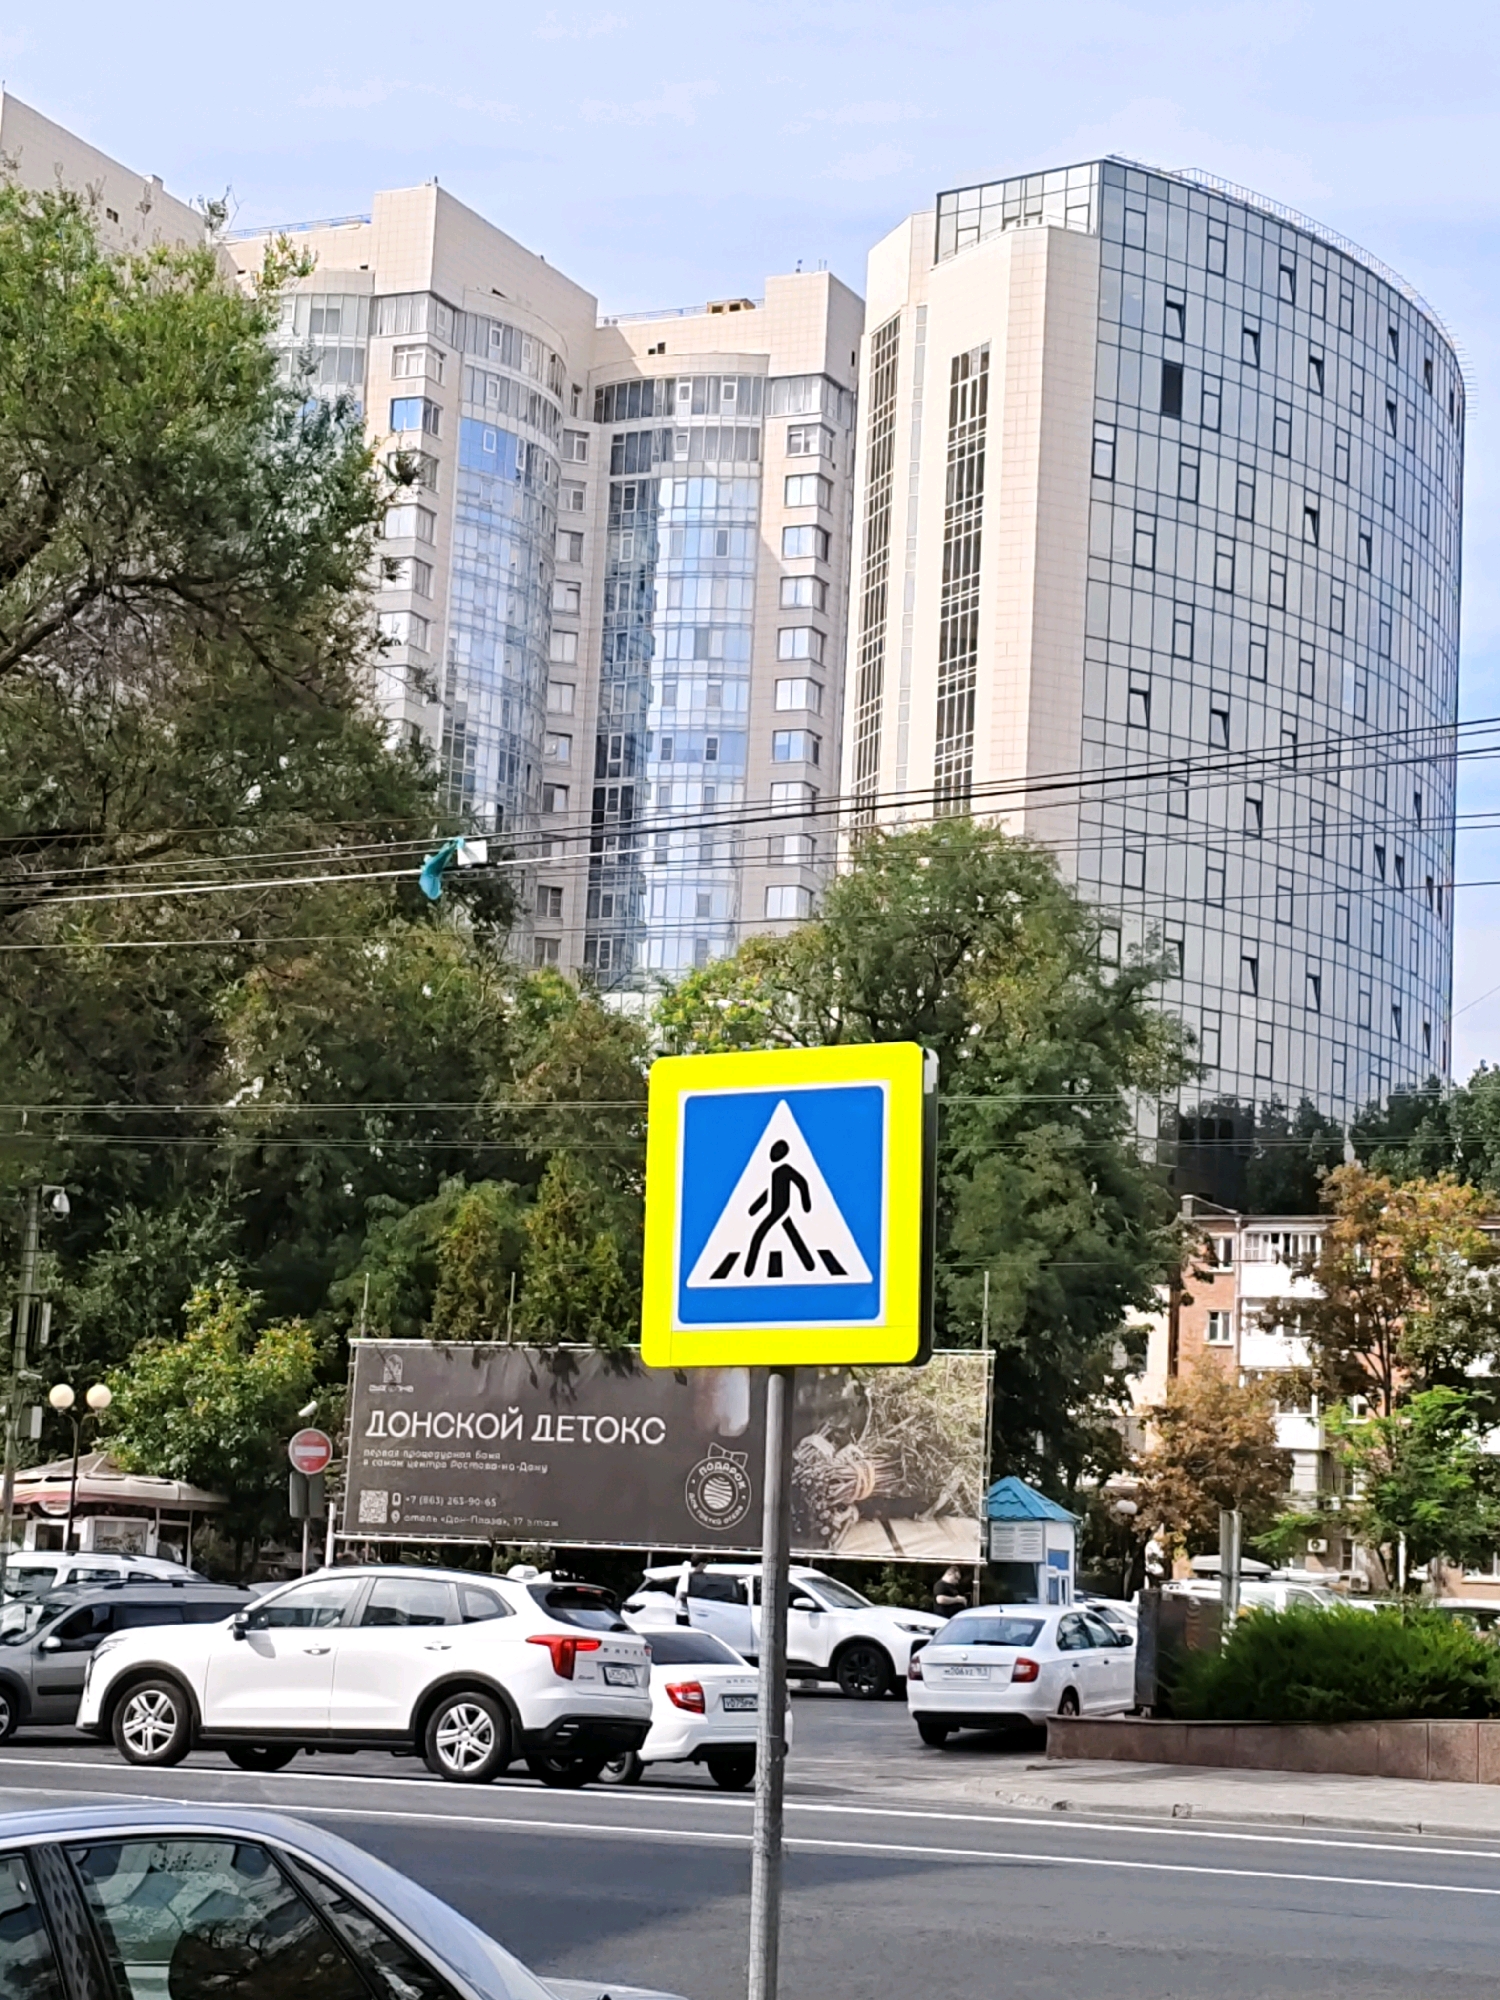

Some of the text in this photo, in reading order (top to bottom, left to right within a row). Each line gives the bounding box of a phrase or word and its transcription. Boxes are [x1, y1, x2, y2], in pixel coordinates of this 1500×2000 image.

[364, 1406, 667, 1445] ДОНСКОЙ ДЕТОКС
[363, 1449, 400, 1458] первая
[698, 1461, 747, 1490] ПОДАРОК
